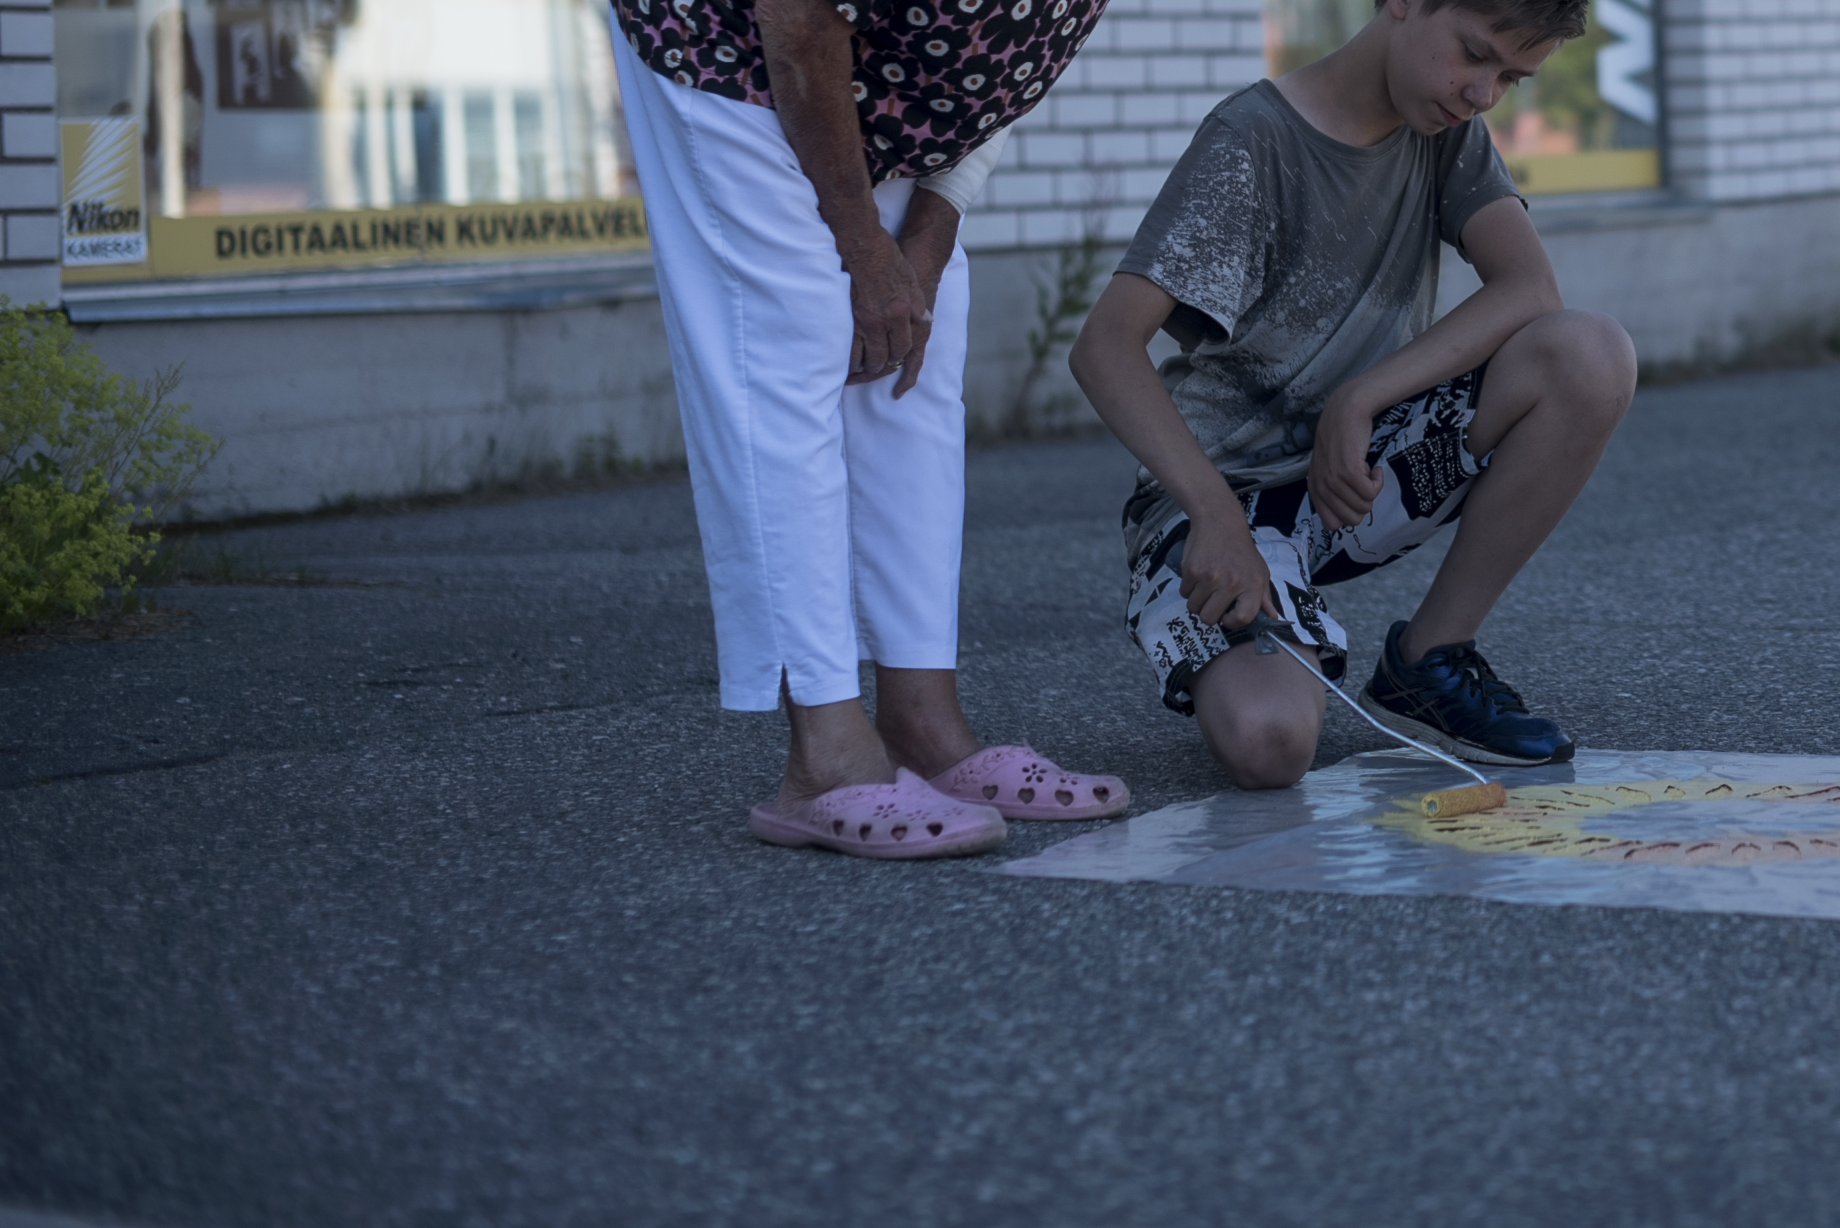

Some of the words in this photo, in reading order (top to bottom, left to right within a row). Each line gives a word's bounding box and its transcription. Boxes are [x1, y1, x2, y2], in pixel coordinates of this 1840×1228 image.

[66, 200, 141, 234] Nikon
[215, 214, 447, 260] DIGITAALINEN
[455, 205, 647, 249] KUVAPALVEL
